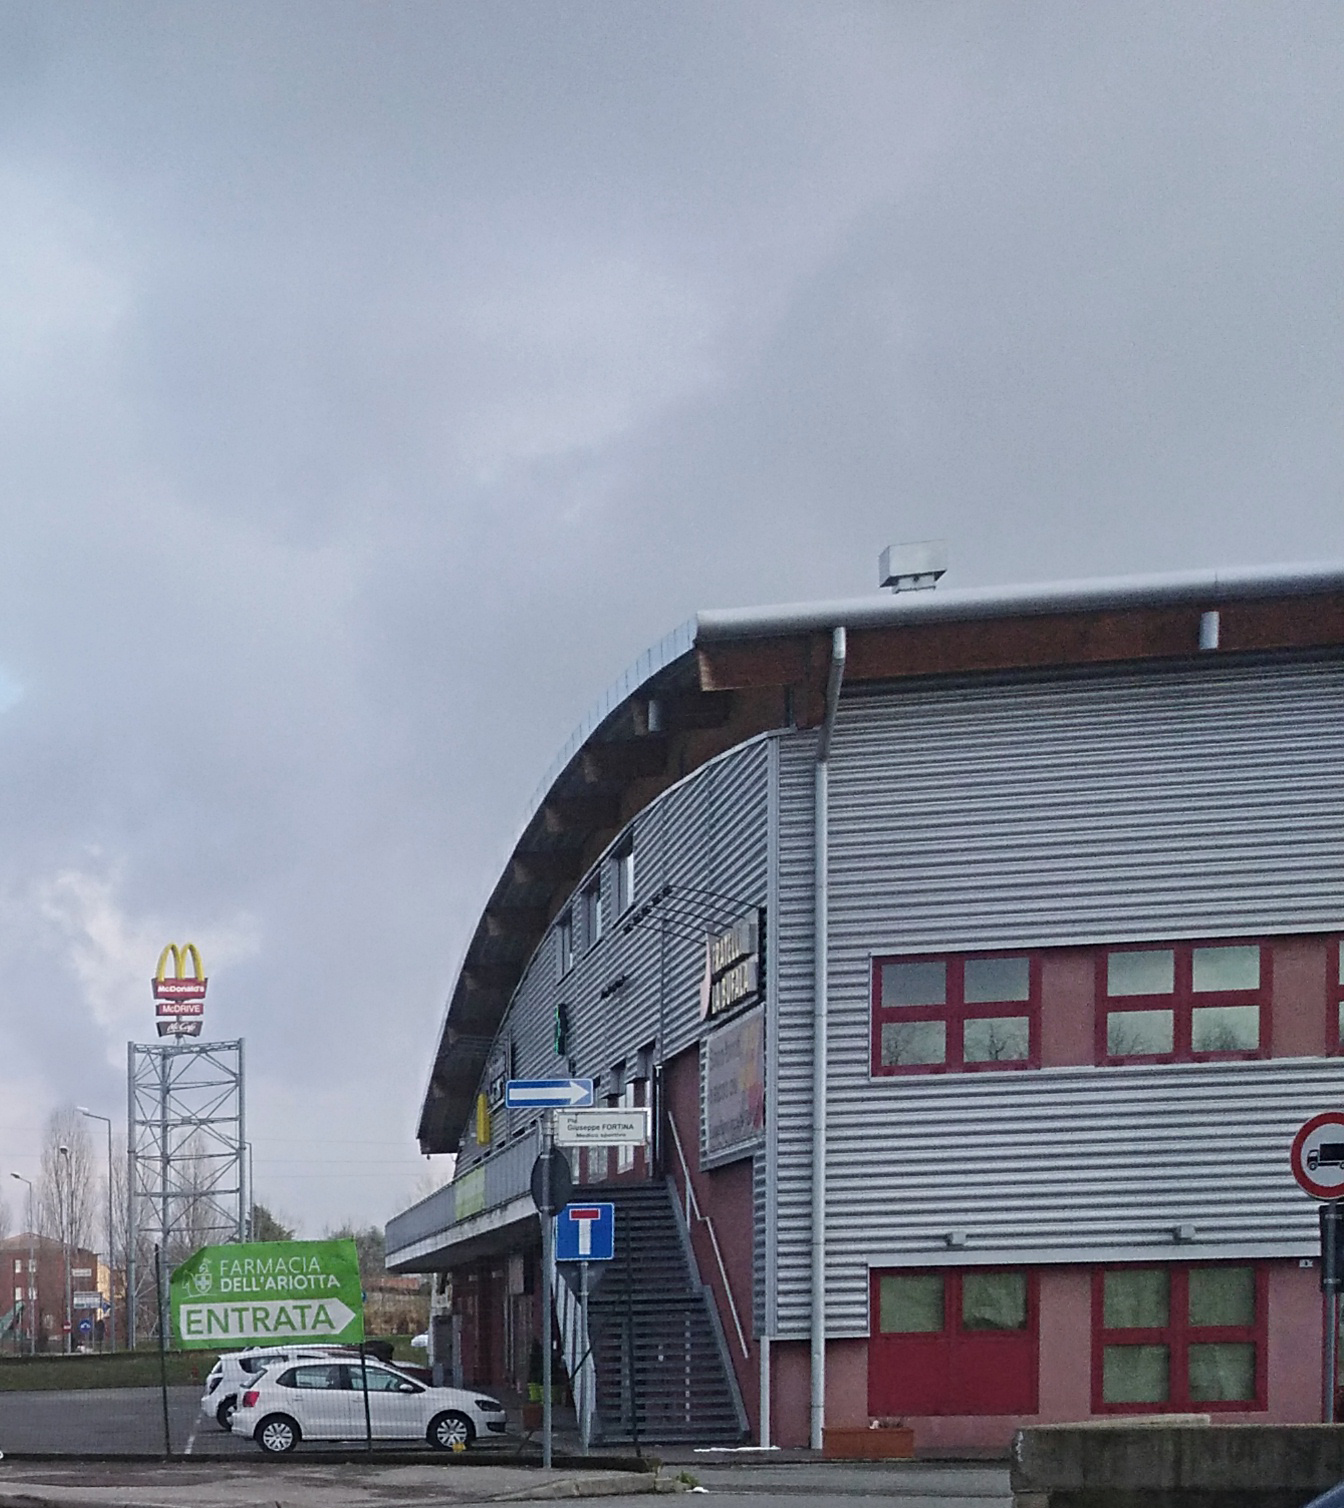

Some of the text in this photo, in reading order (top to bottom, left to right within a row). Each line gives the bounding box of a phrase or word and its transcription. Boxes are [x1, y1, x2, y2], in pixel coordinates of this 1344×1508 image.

[157, 985, 205, 993] McDonald's
[162, 1004, 201, 1013] McDRIVE
[220, 1256, 321, 1276] FARMACIA
[220, 1274, 341, 1293] DELL'ARIOTTA
[186, 1303, 336, 1335] ENTRATA
